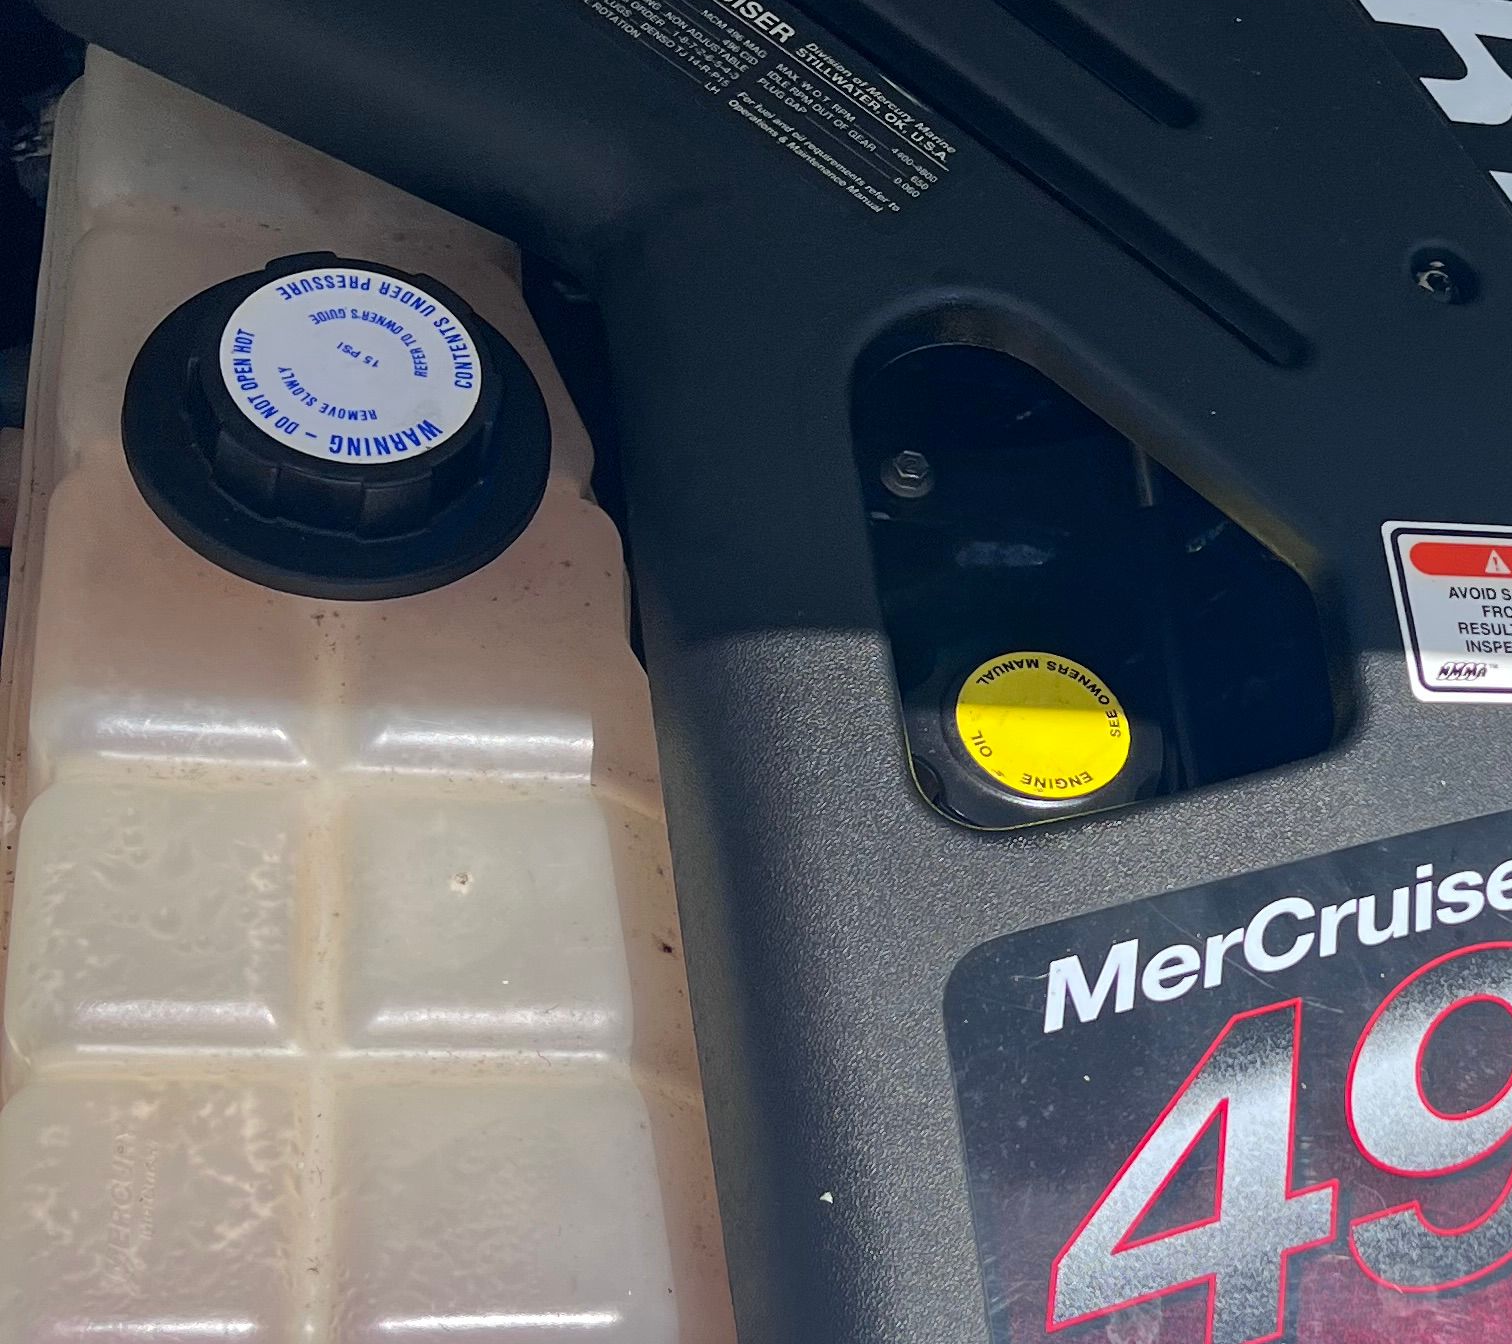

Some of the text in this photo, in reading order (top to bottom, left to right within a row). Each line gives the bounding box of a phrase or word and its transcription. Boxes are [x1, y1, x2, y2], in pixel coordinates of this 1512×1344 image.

[592, 3, 641, 39] ROTATION
[687, 27, 750, 73] ADJUSTABLE
[796, 48, 881, 115] STILLWATER,
[831, 103, 856, 123] RPM
[865, 85, 915, 124] Mercury
[275, 274, 473, 389] CONTENTS UNDER PRESSURE
[308, 308, 347, 325] GUIDE
[336, 341, 380, 368] 15 PSI
[401, 332, 416, 349] TO
[411, 346, 428, 378] REFER
[233, 328, 444, 457] WARNING DO NOT OPEN HOT
[277, 366, 378, 421] REMOVE SLOWLY
[1449, 586, 1497, 602] AVOID
[976, 658, 1121, 738] SEE OWNERS MANUAL
[971, 730, 1094, 789] ENGINE OIL
